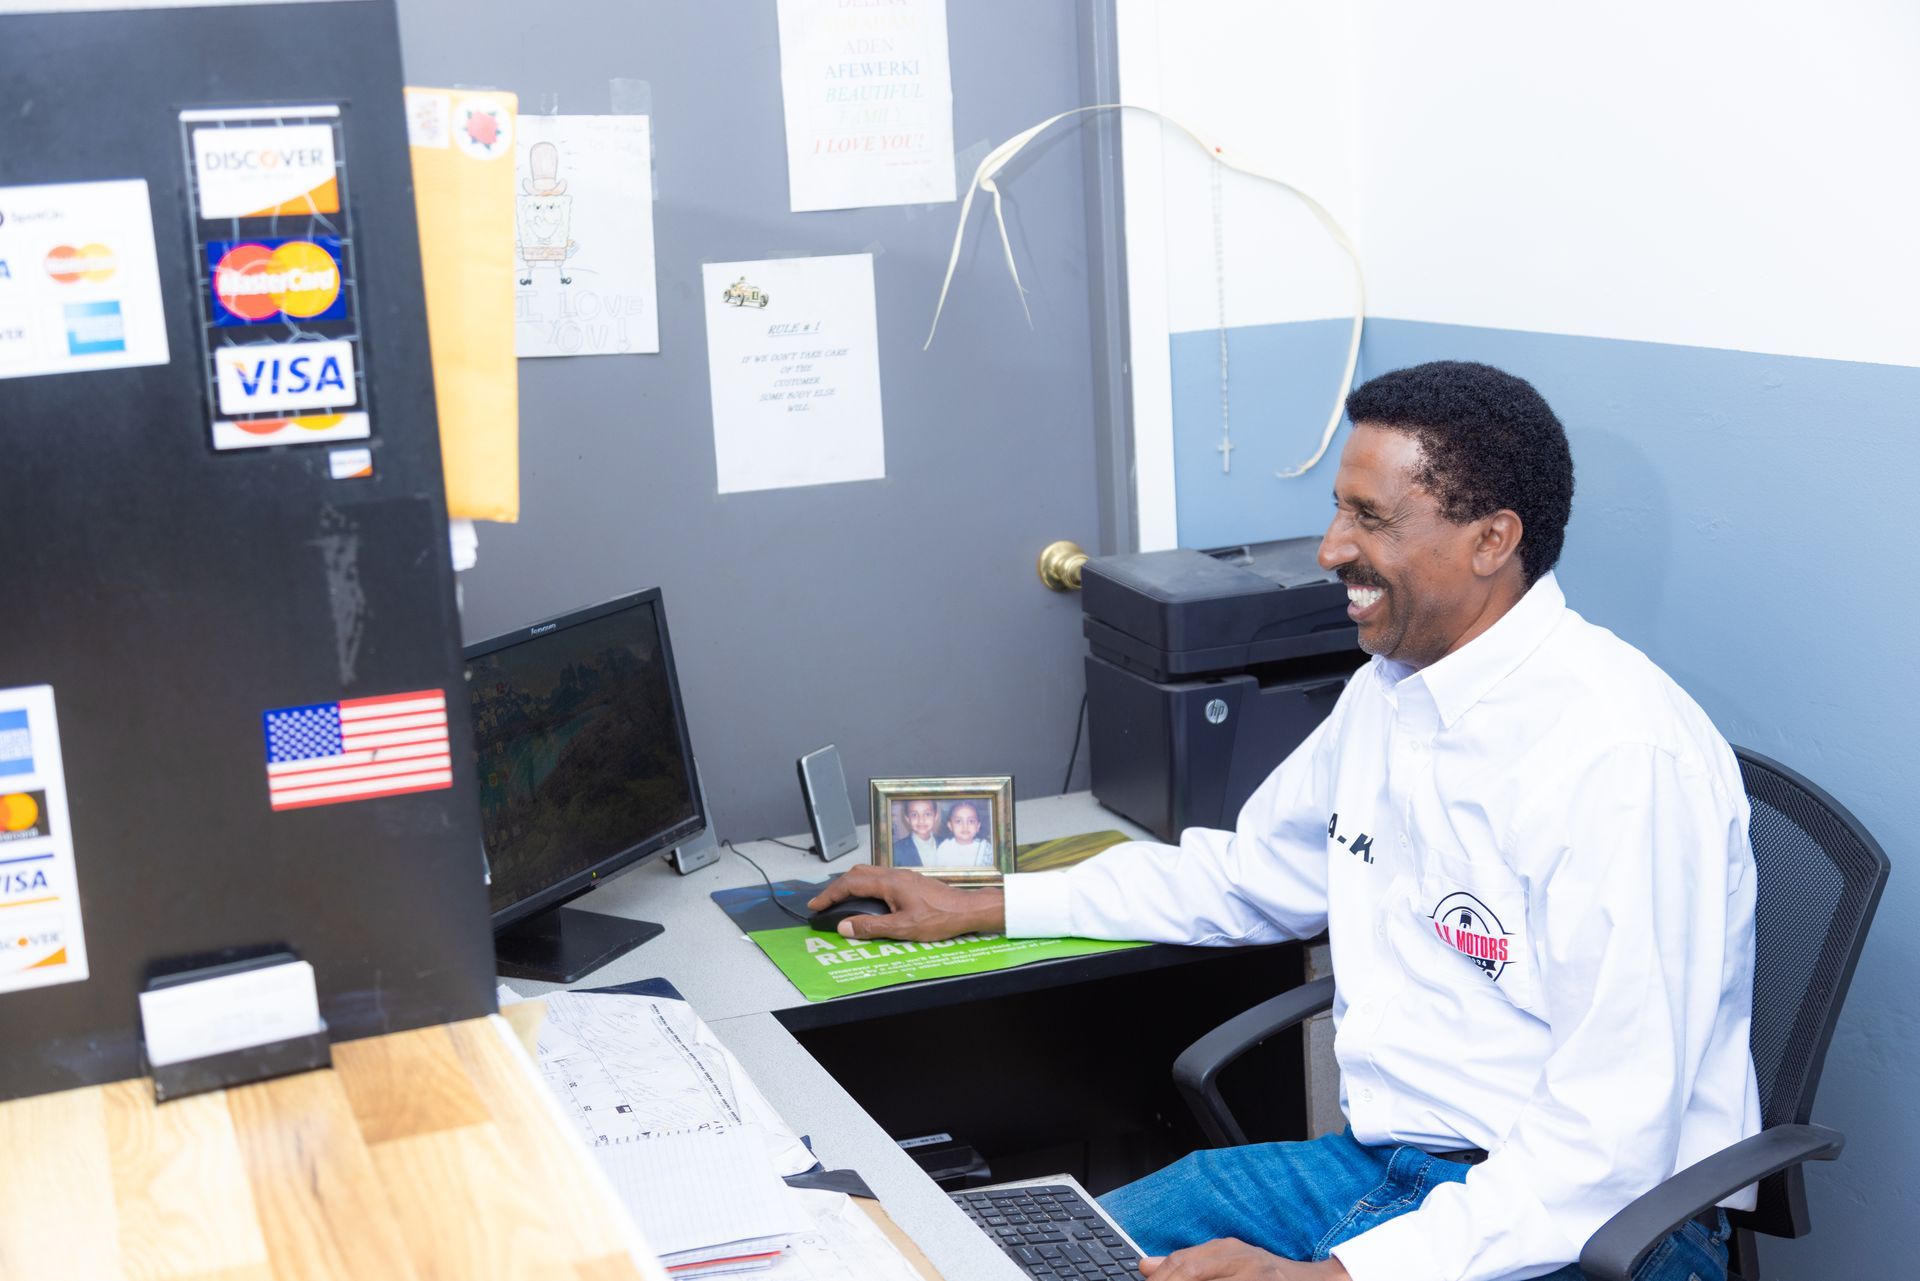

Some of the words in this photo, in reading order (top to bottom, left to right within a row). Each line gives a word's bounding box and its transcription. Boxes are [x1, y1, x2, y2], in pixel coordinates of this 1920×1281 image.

[825, 60, 920, 80] AFEWERKI
[826, 83, 925, 103] BEAUTIFUL
[814, 138, 822, 154] I
[827, 135, 877, 153] LOVE
[205, 148, 323, 171] DISCOVER
[218, 267, 334, 295] MasterCard
[768, 322, 800, 335] RULE
[234, 356, 346, 396] VISA
[0, 869, 48, 894] ISA
[805, 937, 838, 954] A
[1456, 929, 1509, 961] MOTORS
